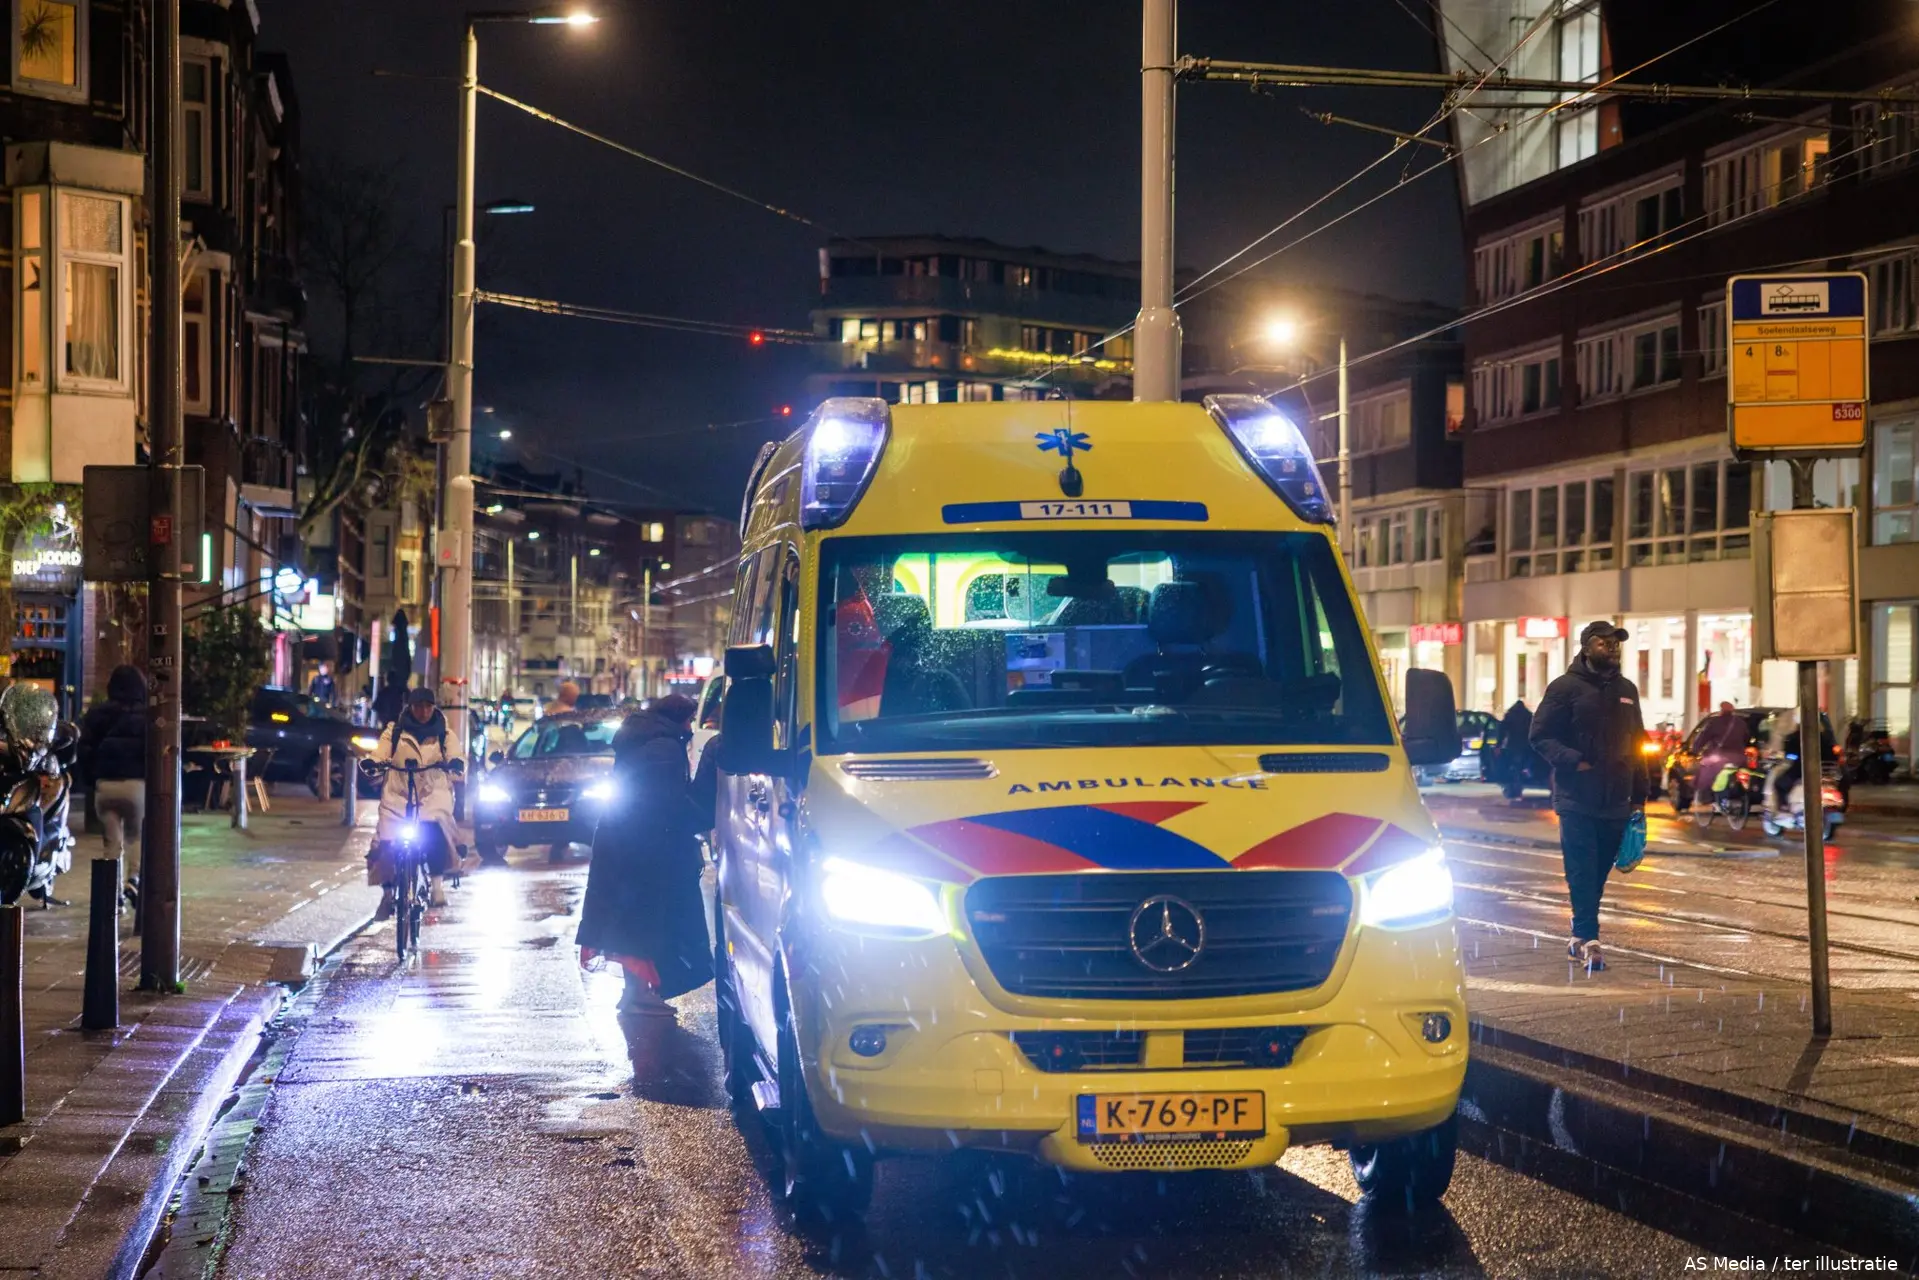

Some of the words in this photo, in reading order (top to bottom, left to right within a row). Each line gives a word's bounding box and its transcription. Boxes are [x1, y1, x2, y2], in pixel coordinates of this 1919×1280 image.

[1746, 346, 1753, 357] 4
[1775, 345, 1783, 357] 8
[1039, 503, 1113, 516] 17-111
[1007, 776, 1270, 795] AMBULANCE
[1106, 1097, 1249, 1128] K-769-PF
